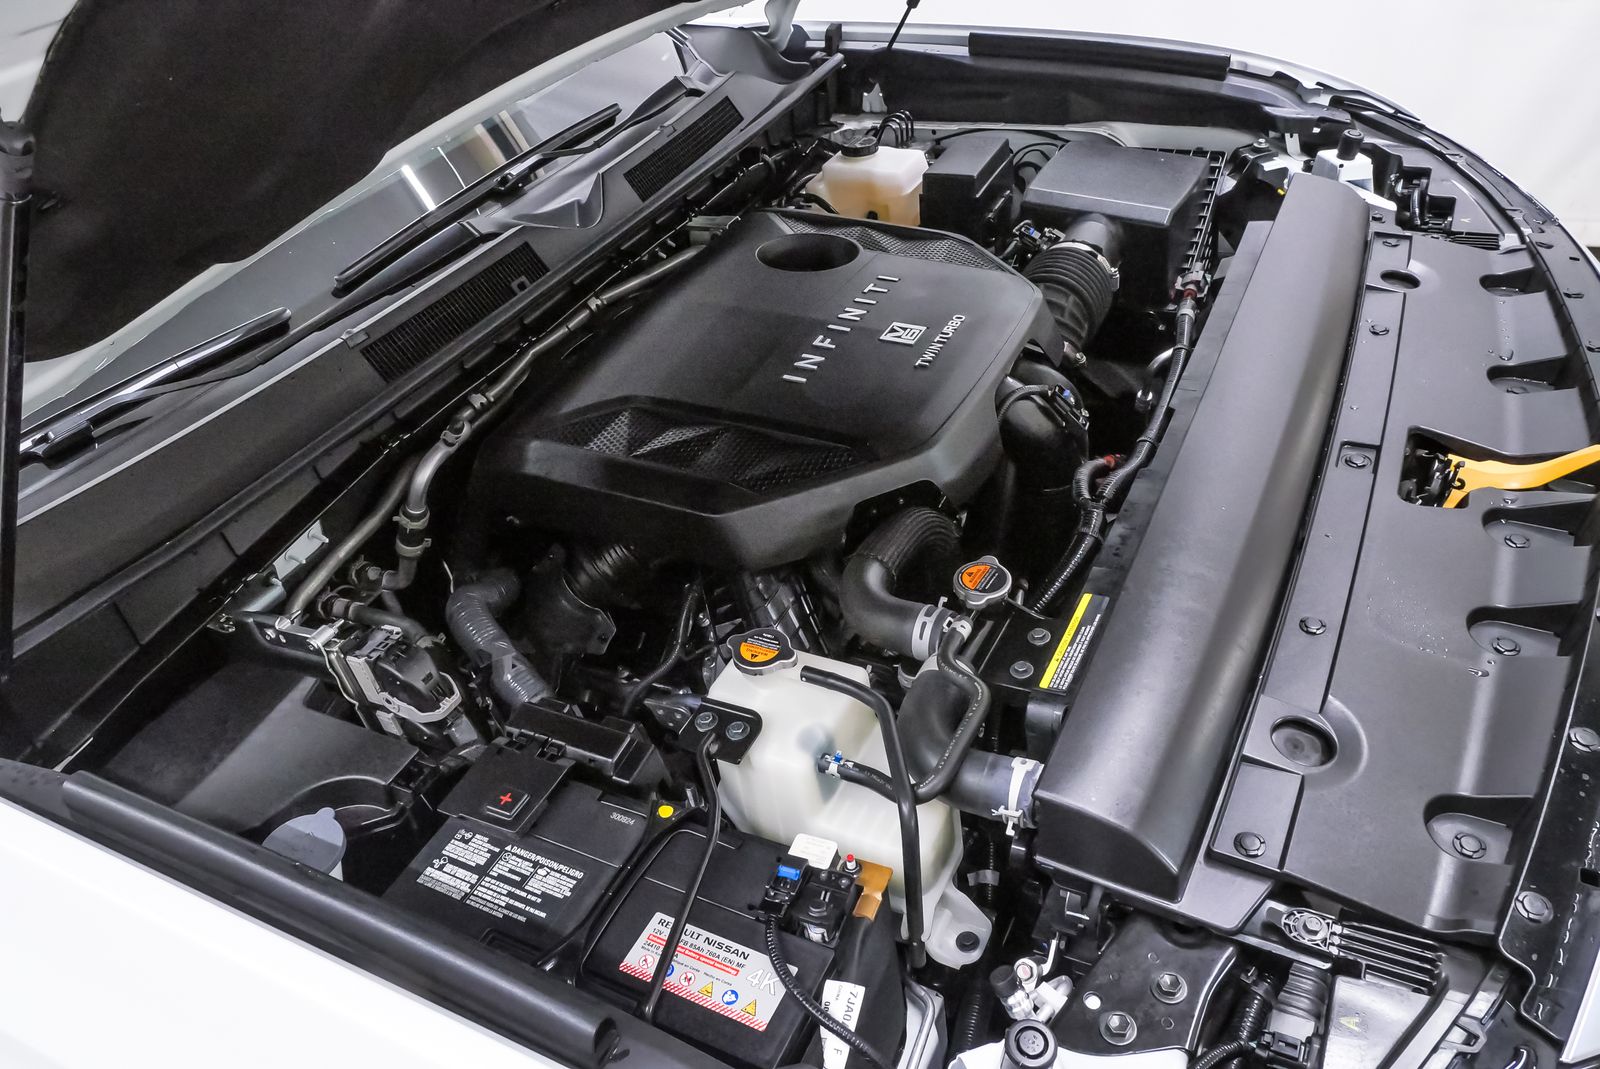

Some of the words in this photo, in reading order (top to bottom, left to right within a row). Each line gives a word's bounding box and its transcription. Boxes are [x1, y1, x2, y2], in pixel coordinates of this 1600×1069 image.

[782, 275, 900, 383] INFINITI
[915, 340, 943, 367] TWIN
[934, 314, 966, 344] TURBO
[652, 928, 664, 936] 12V
[689, 942, 705, 953] 85Ah
[705, 948, 720, 960] 760A
[721, 953, 736, 967] (EN)
[736, 960, 746, 969] MF
[657, 918, 702, 940] REULT
[703, 936, 750, 960] NISSAN
[746, 968, 779, 996] 4K
